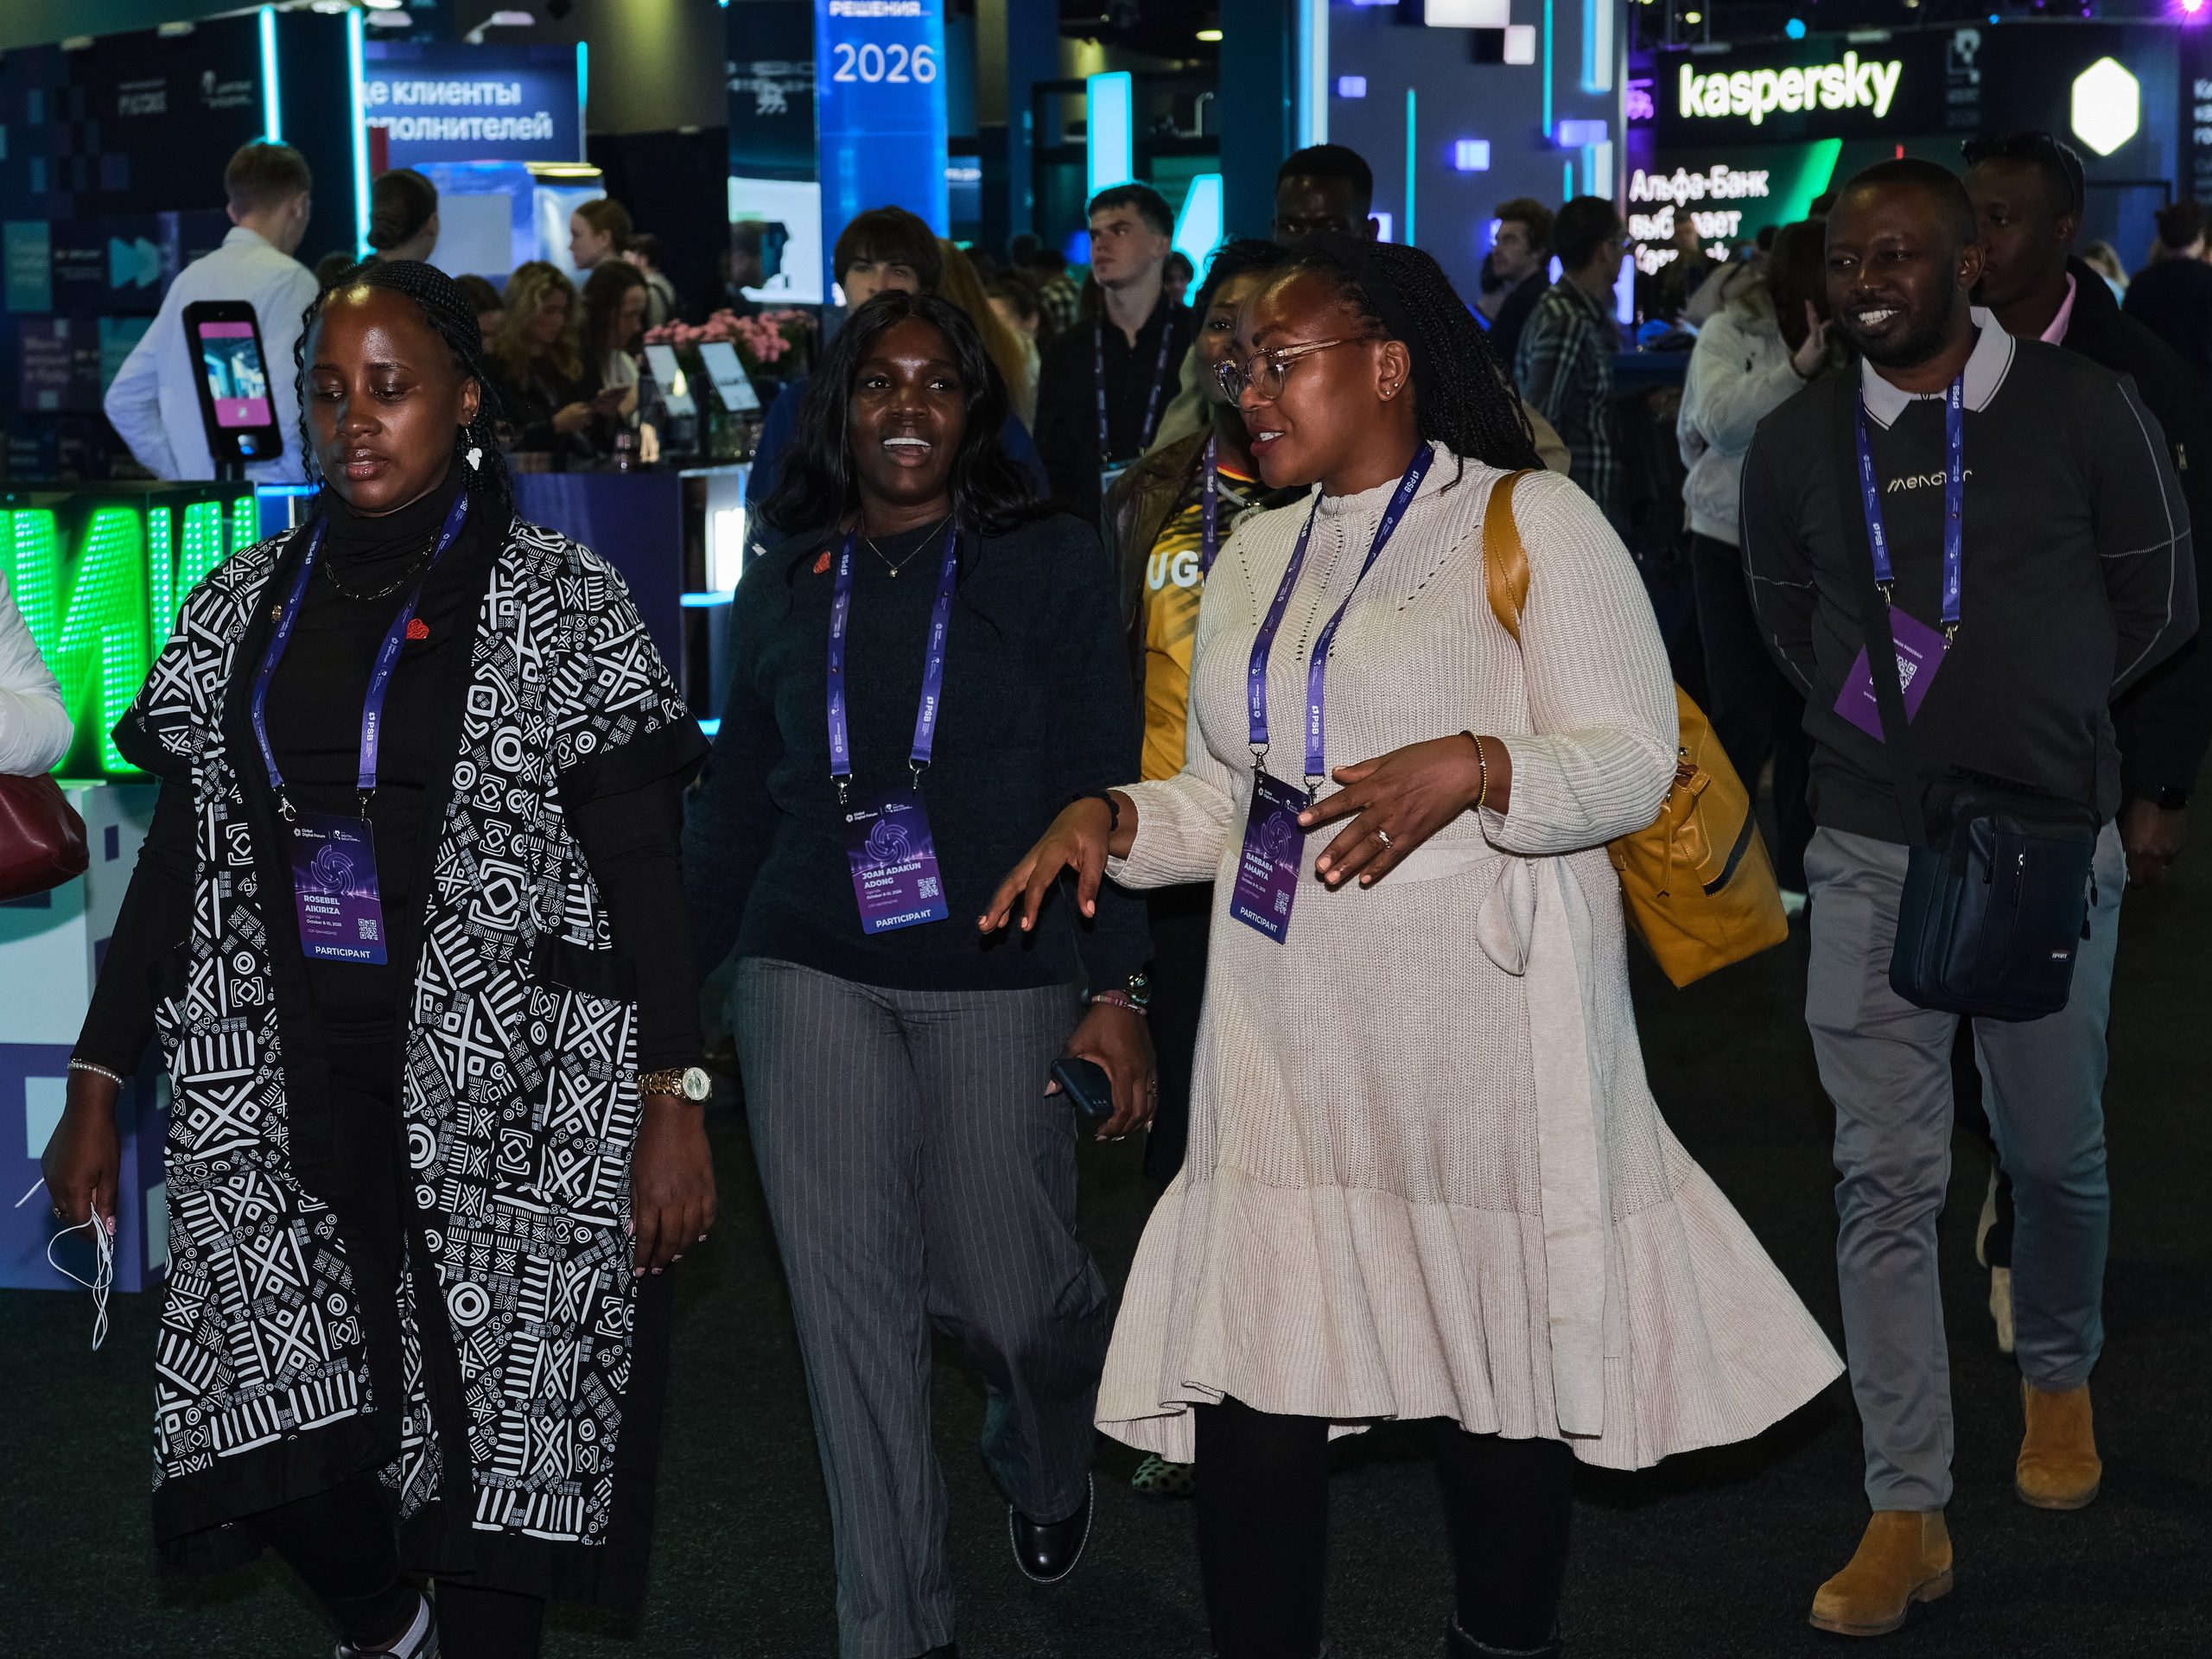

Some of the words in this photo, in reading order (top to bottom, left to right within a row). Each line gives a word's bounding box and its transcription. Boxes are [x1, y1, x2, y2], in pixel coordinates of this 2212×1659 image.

[833, 43, 936, 84] 2026
[391, 80, 522, 105] клиенты
[1680, 51, 1903, 125] kaspersky
[1629, 164, 1770, 207] Альфа-Банк
[1629, 205, 1743, 240] выбает
[1404, 477, 1417, 493] PSB
[1874, 531, 1883, 546] PSB
[1147, 550, 1205, 590] UG
[924, 704, 933, 722] PSB
[366, 721, 375, 741] PSB
[862, 868, 885, 880] JOAN
[887, 862, 921, 875] ADAKUN
[1244, 862, 1268, 880] AMANYA
[1246, 852, 1274, 873] BARBARA
[864, 877, 894, 889] ADONG
[304, 895, 340, 905] ROSEBEL
[305, 905, 340, 915] AIKIRIZA
[876, 910, 931, 927] PARTICIPANT
[1240, 906, 1278, 933] PARTICIPANT
[315, 946, 371, 958] PARTICIPANT
